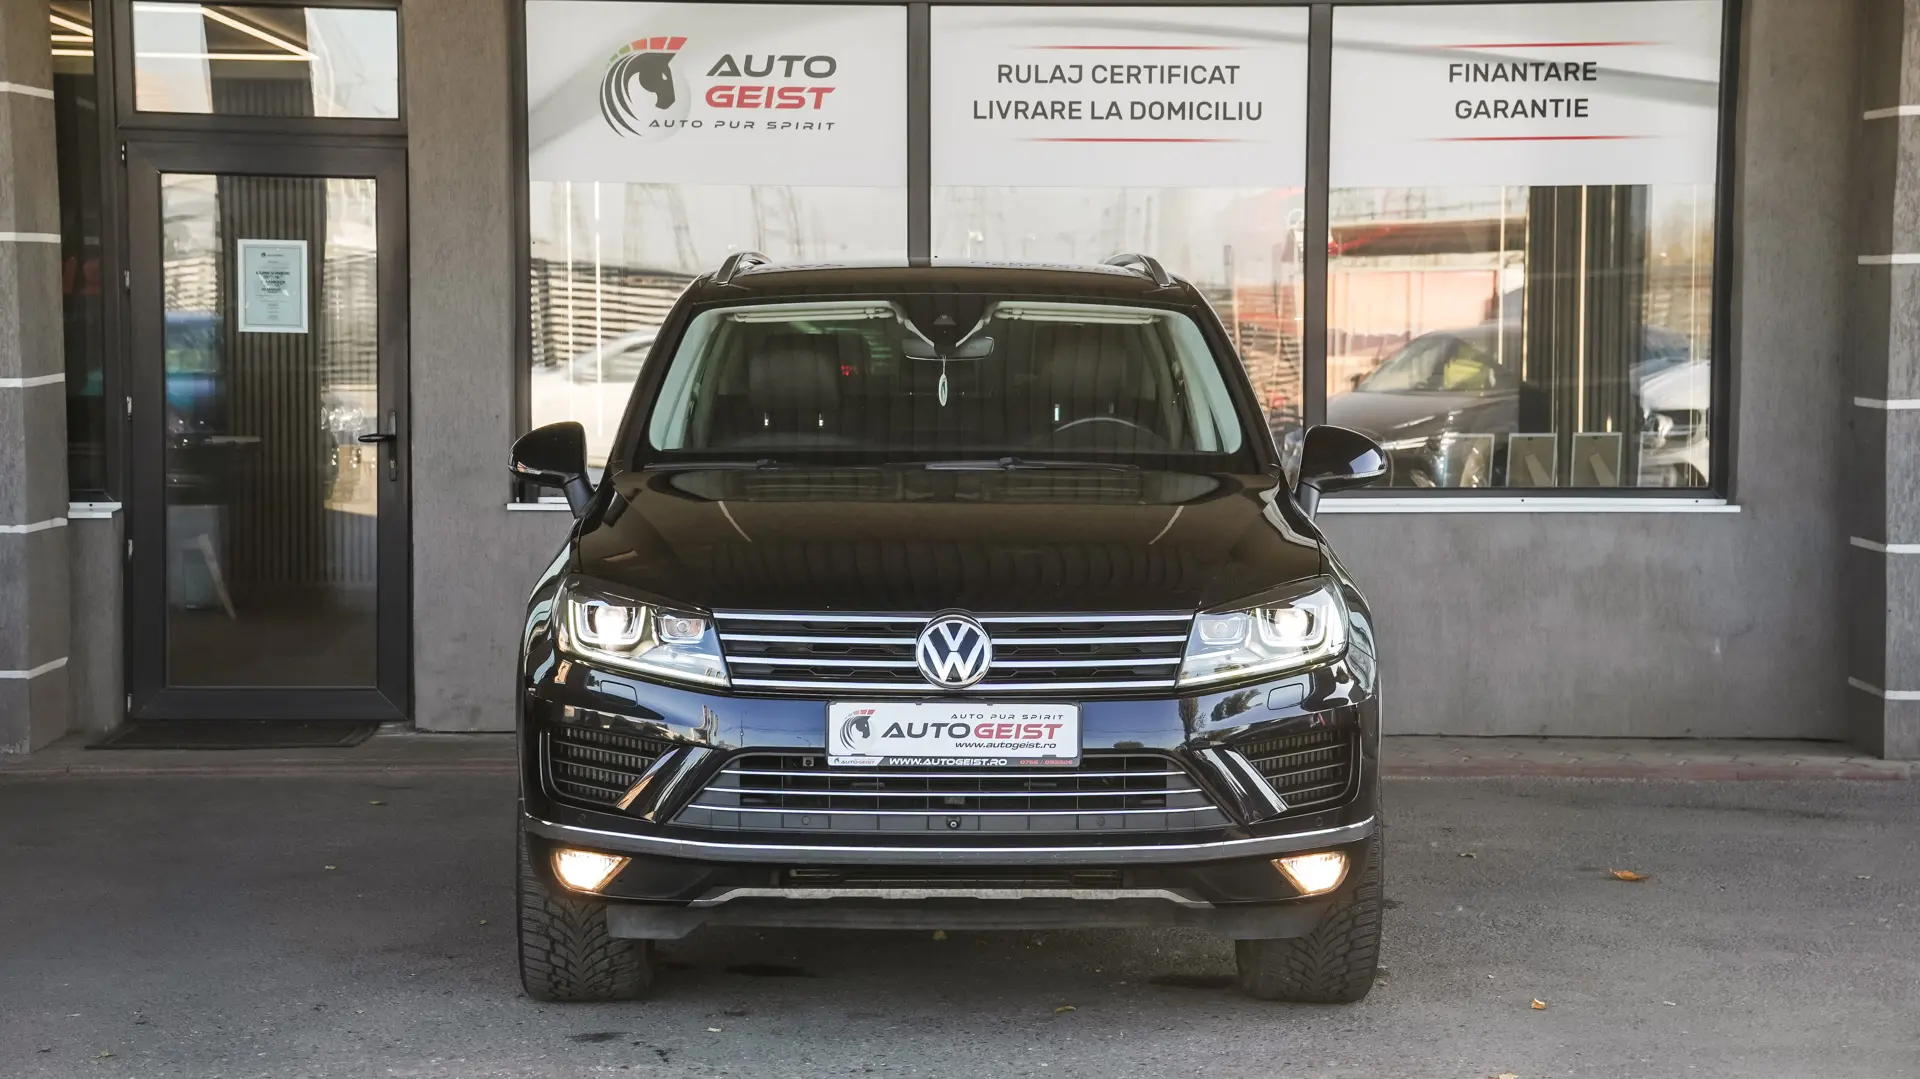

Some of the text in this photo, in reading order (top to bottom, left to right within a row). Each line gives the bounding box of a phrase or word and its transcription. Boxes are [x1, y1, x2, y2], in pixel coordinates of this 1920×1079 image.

[706, 53, 837, 79] AUTO
[997, 64, 1240, 85] RULAJ CERTIFICAT
[1449, 61, 1597, 83] FINANTARE
[705, 85, 836, 110] GEIST
[973, 100, 1262, 121] LIVRARE LA DOMICILIU
[1455, 98, 1588, 119] GARANTIE
[648, 119, 836, 131] AUTO PUR SPIRIT
[918, 616, 990, 688] VW
[955, 741, 1057, 750] www.autogeist.ro
[888, 757, 1008, 767] WWW.AUTOGEIST.RO
